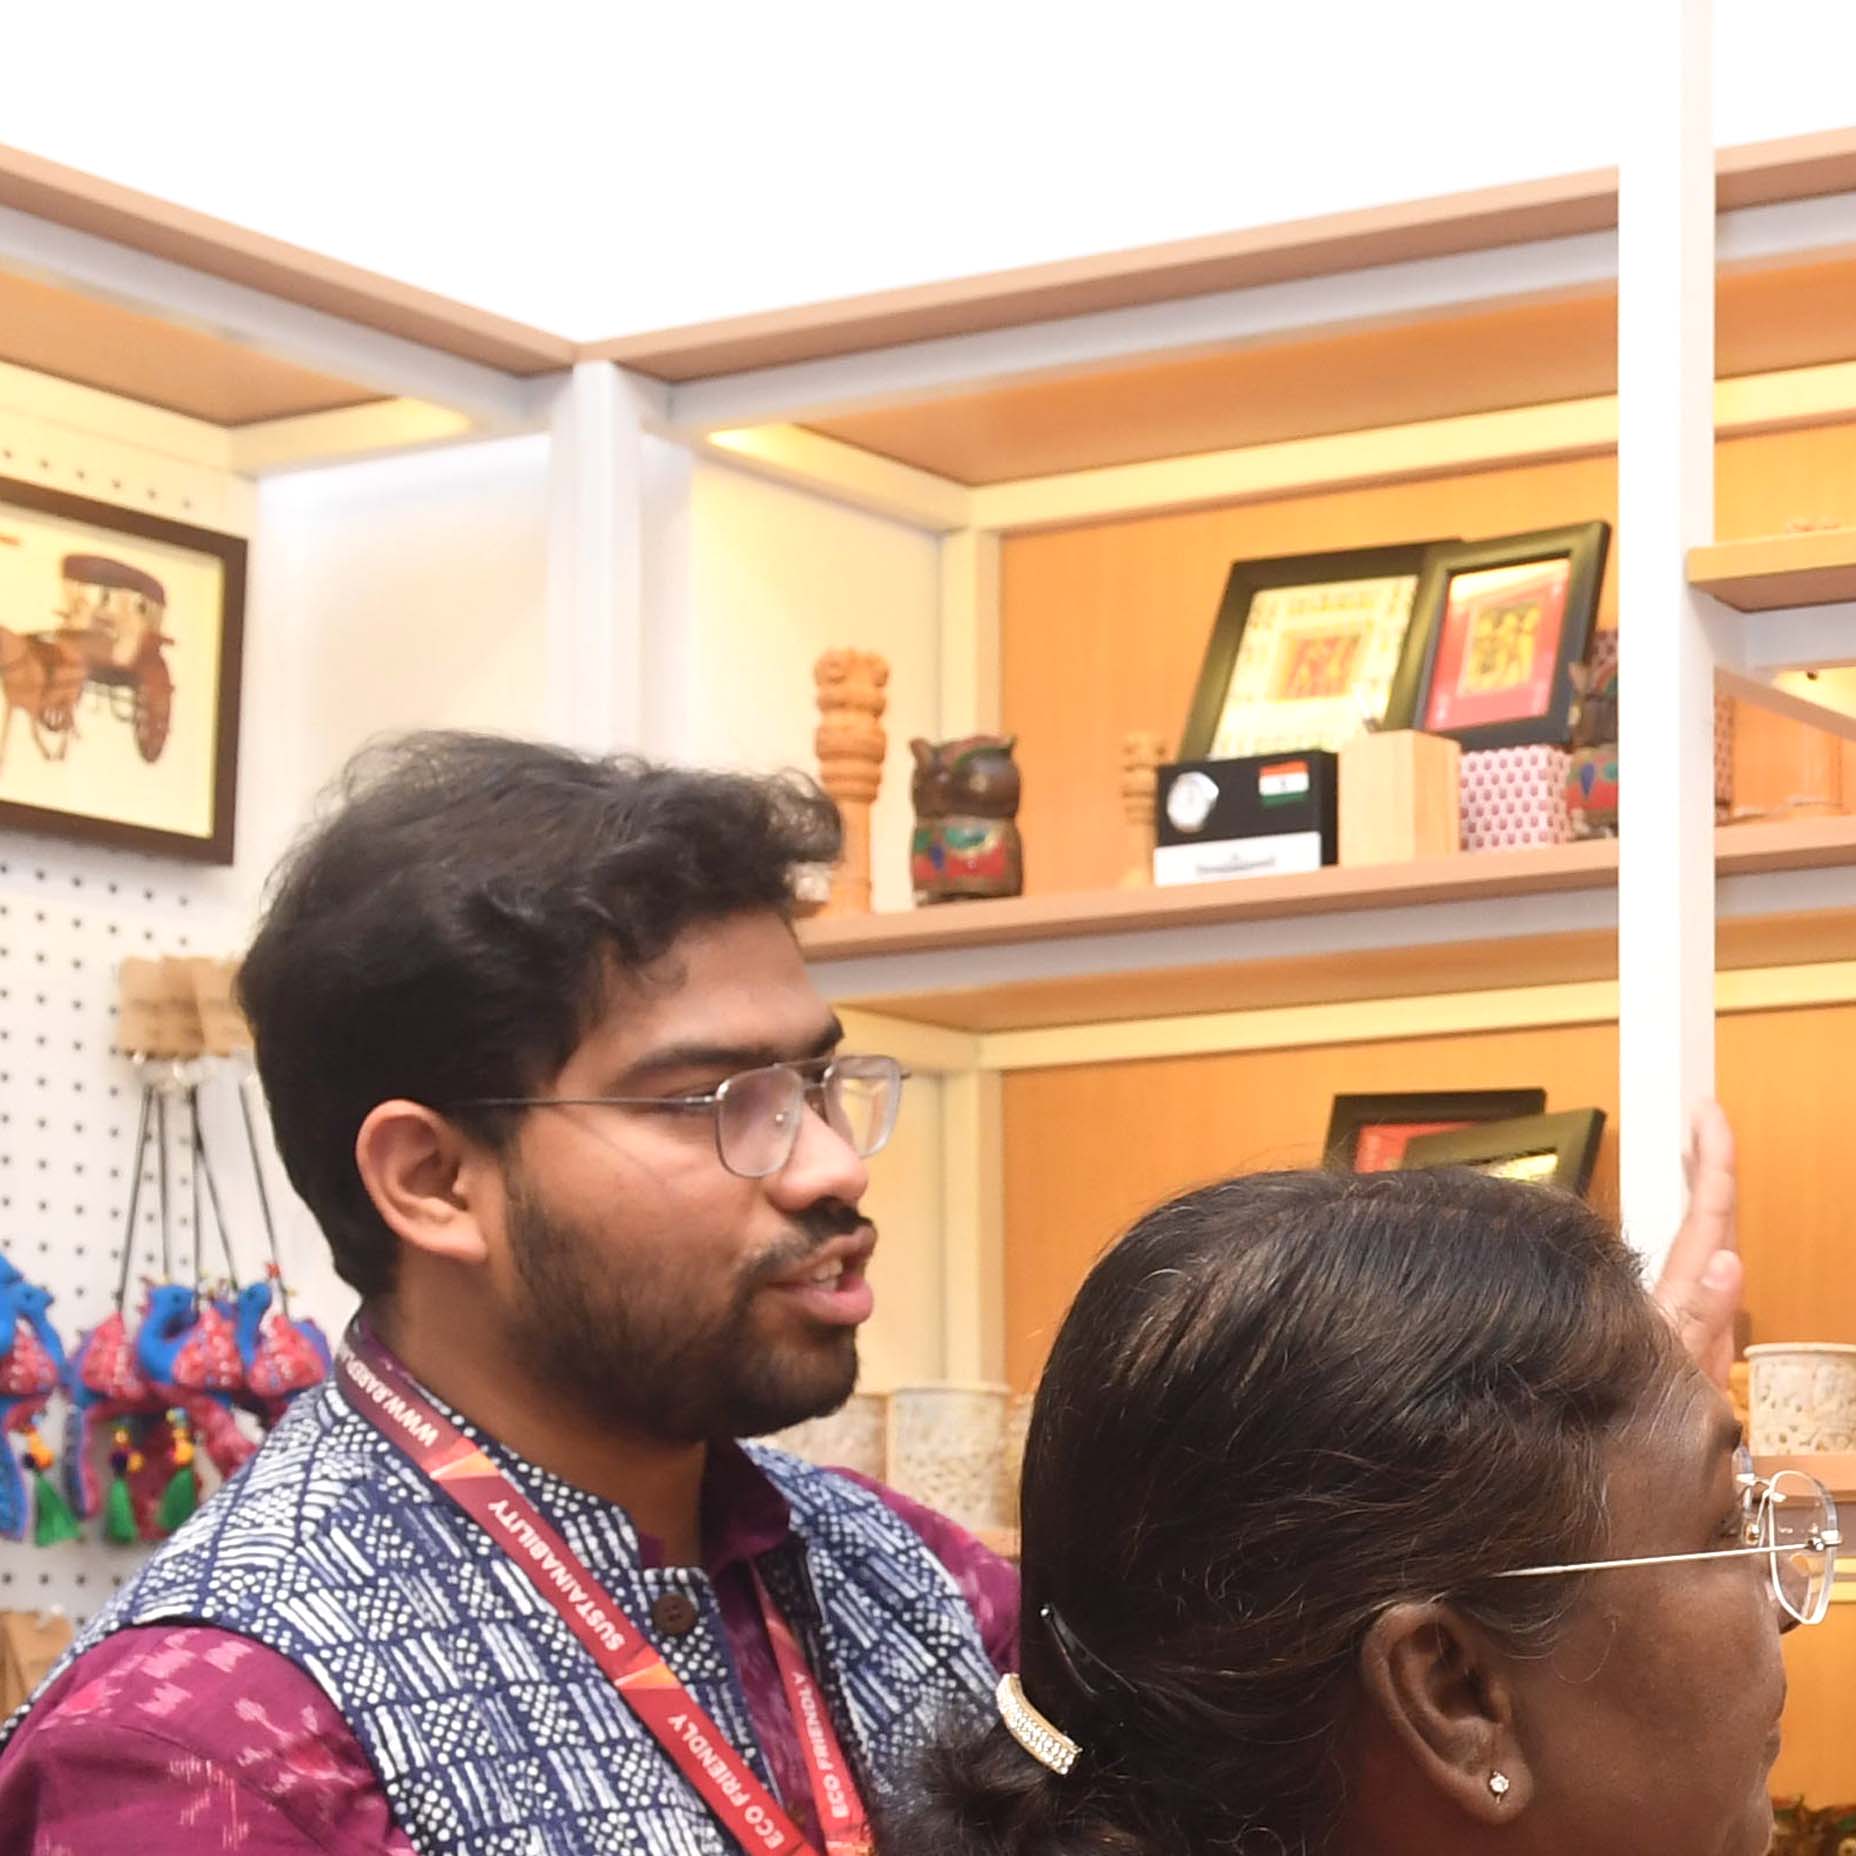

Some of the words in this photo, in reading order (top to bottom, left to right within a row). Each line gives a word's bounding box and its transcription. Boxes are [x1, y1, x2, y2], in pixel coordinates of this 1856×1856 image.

[488, 1499, 625, 1651] SUSTAINABILITY
[667, 1714, 751, 1807] FRIENDLY
[792, 1672, 833, 1770] FRIENDLY
[744, 1805, 785, 1849] ECO
[823, 1774, 849, 1818] ECO
